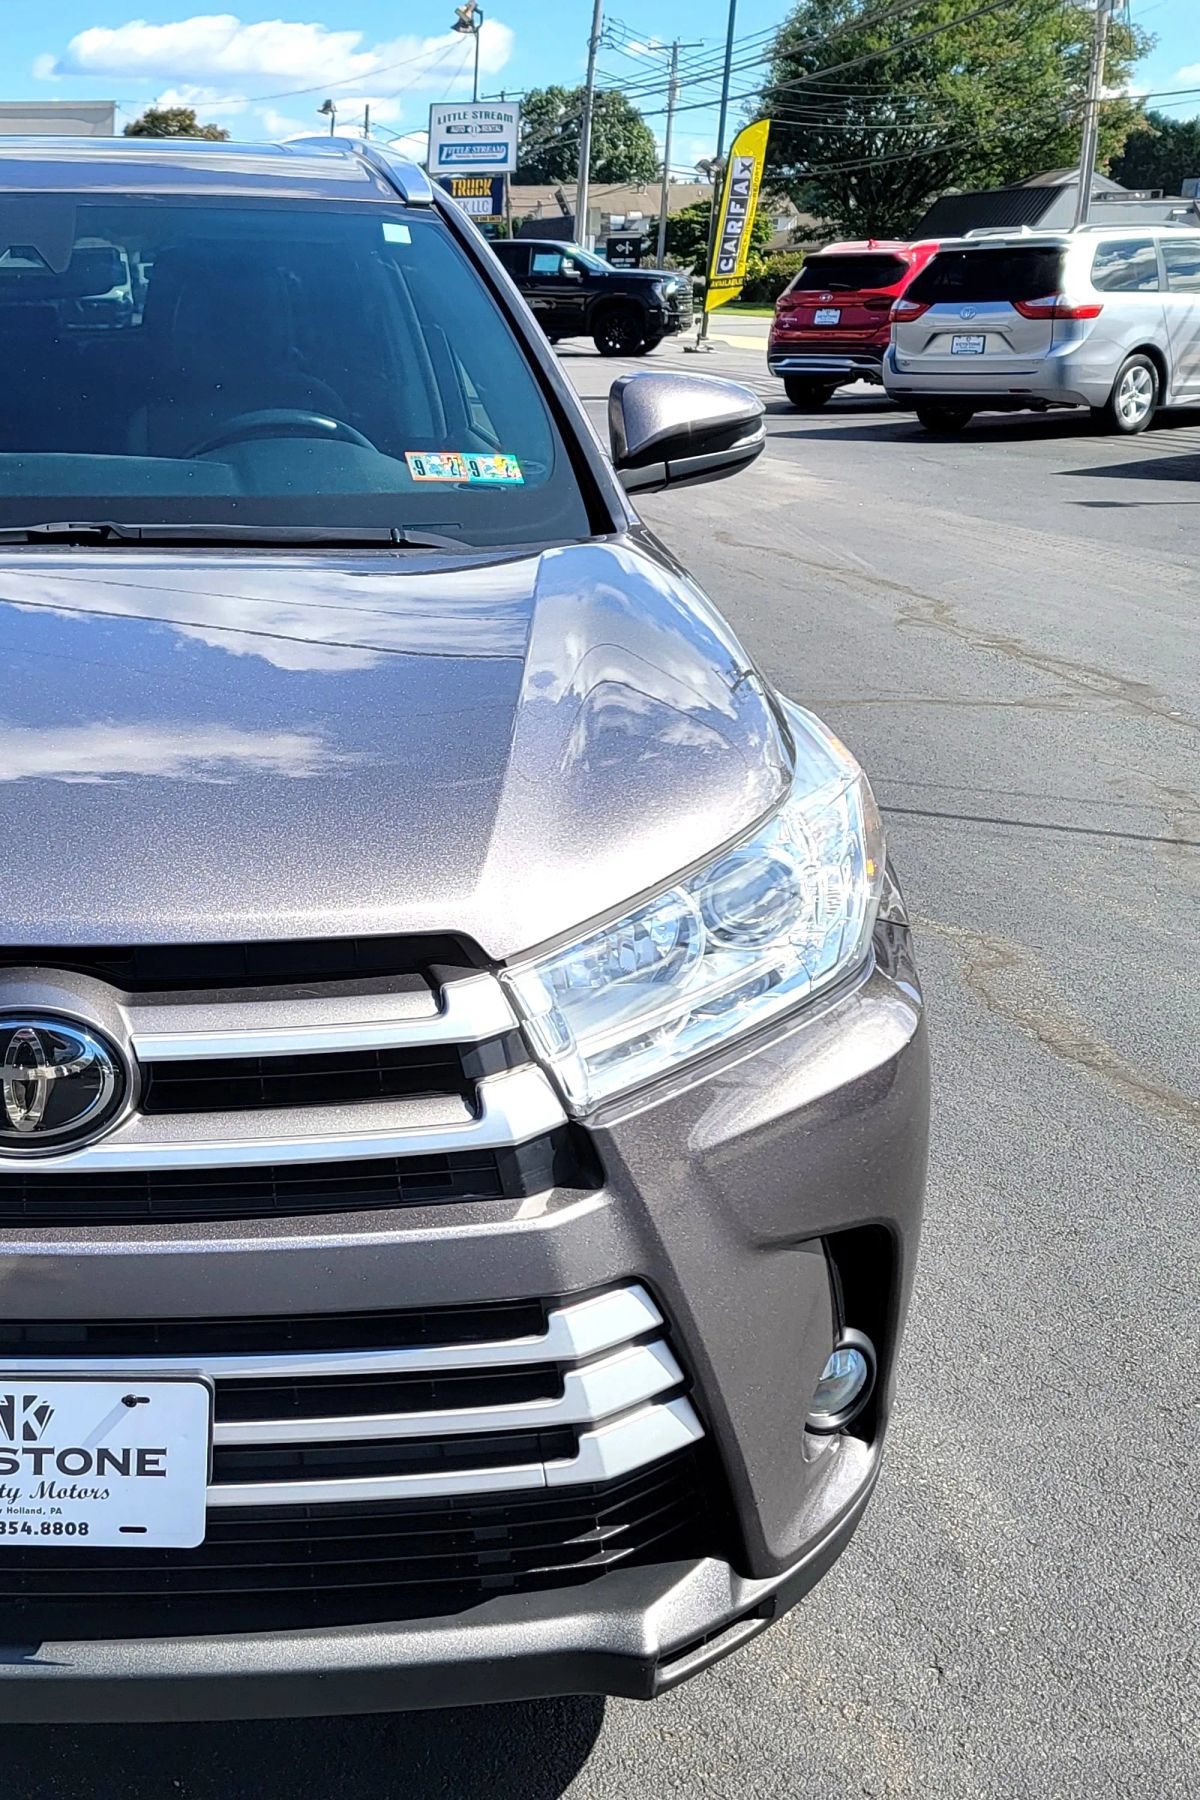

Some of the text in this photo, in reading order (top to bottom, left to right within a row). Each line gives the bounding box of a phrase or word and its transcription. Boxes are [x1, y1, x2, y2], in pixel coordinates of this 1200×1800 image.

[438, 111, 513, 125] LITTLE STREAM
[451, 178, 492, 197] TRUCK
[472, 200, 489, 213] LLC
[720, 160, 752, 272] CARFAX
[414, 459, 426, 476] 9
[29, 1481, 110, 1500] Motors
[7, 1507, 46, 1515] Holland,
